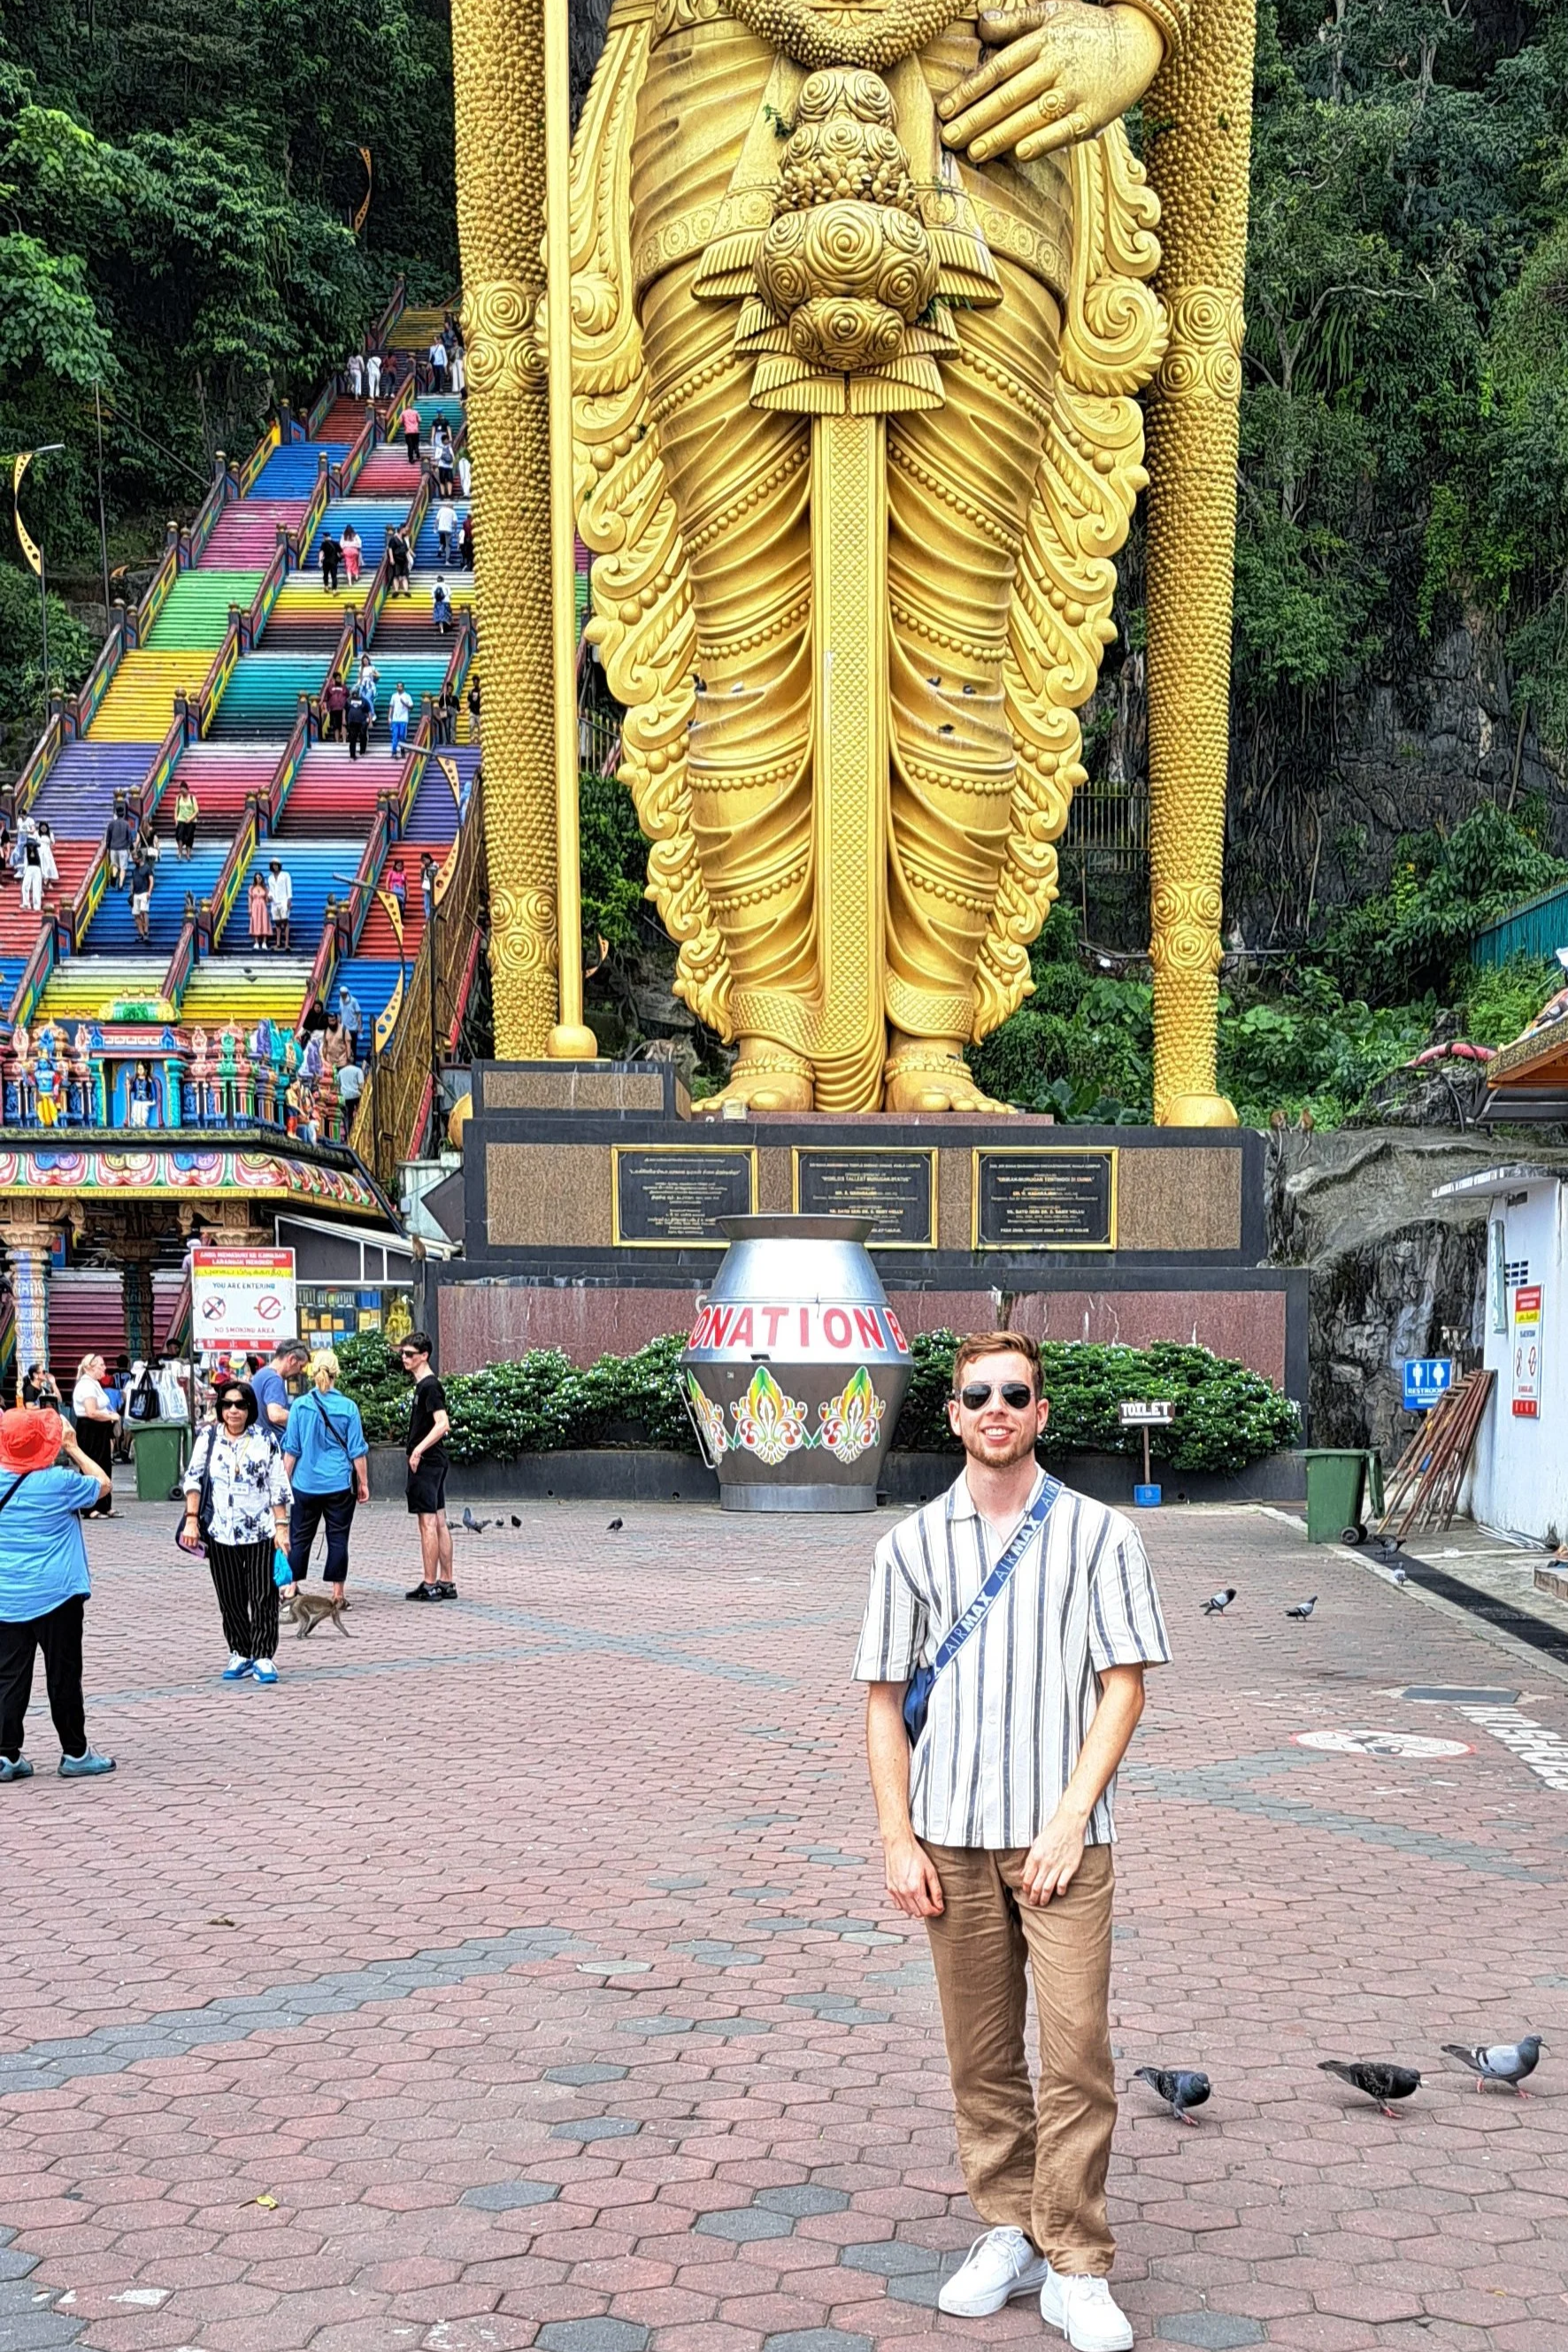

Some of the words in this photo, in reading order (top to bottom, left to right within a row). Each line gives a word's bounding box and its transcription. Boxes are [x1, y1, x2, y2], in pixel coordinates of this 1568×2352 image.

[1121, 1402, 1171, 1417] TOILET
[995, 1514, 1041, 1582] AIRMAX
[945, 1590, 995, 1655] AIRMAX
